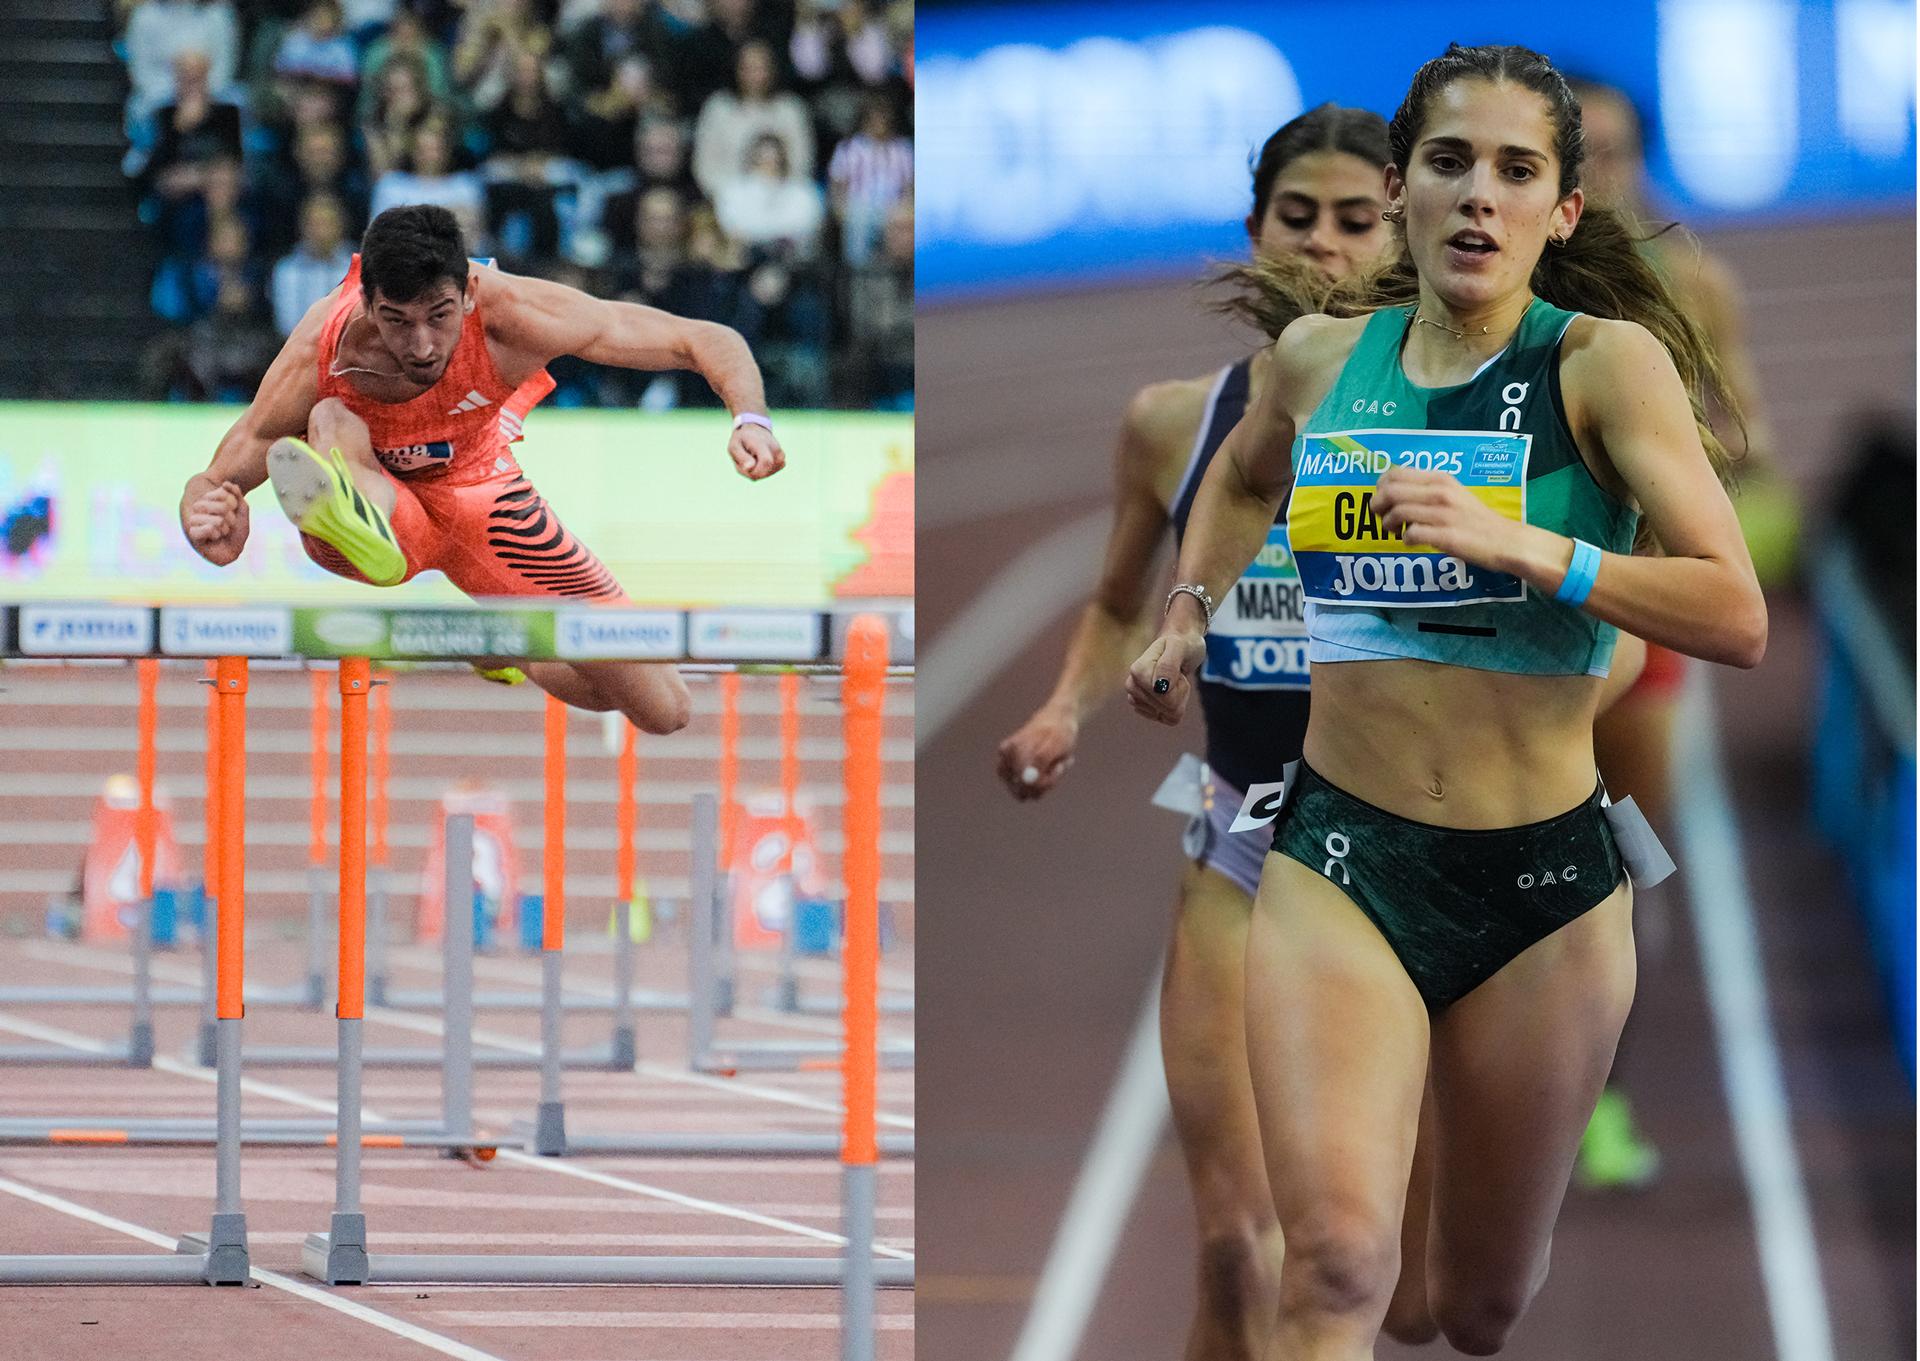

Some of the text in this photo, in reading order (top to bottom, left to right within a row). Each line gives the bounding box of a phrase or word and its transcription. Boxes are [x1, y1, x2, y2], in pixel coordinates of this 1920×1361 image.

[1352, 399, 1397, 416] OAC
[1302, 450, 1464, 476] MADRID 2025
[1482, 453, 1509, 461] TEAM
[1333, 555, 1473, 596] Joma
[1517, 865, 1578, 889] OAC
